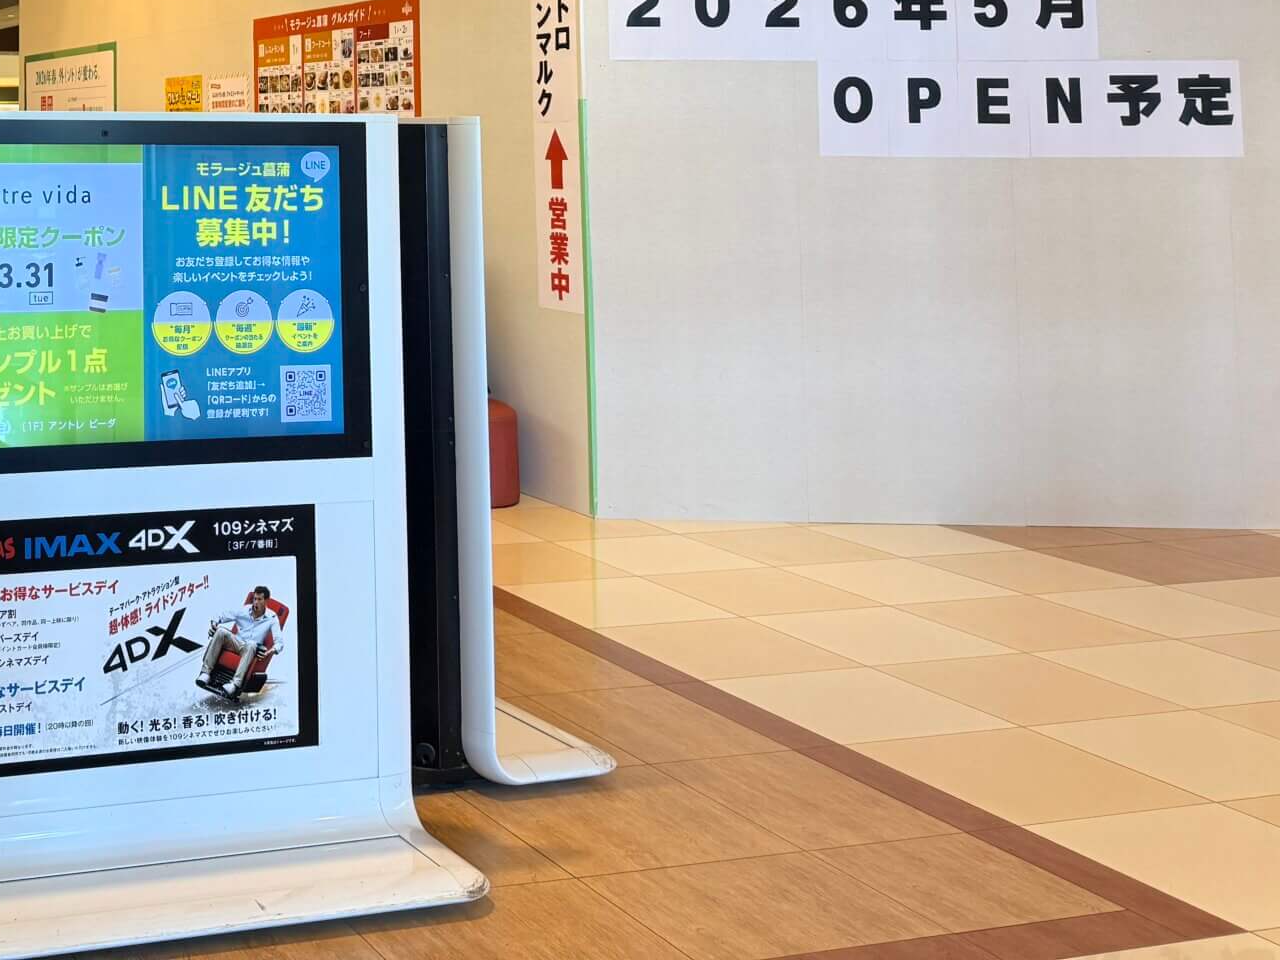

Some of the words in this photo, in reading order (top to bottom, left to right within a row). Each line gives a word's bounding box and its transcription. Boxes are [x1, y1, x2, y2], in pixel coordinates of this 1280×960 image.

[195, 162, 291, 177] モラージュ菖蒲
[305, 159, 326, 170] LINE
[41, 184, 92, 205] vida
[161, 185, 238, 211] LINE
[244, 183, 324, 213] 友だち
[195, 218, 290, 247] 募集中!
[548, 196, 570, 301] 営業中
[175, 255, 311, 268] お友だち登録してお得な情報や
[172, 269, 313, 283] 楽しいイベントをチェックしよう!
[33, 295, 49, 303] tue
[206, 367, 252, 377] LINEアプリ
[206, 407, 270, 419] 登録が便利です!
[48, 420, 84, 430] アントレ
[89, 418, 117, 429] ビーダ
[212, 516, 295, 537] 109シネマズ
[24, 532, 123, 560] IMAX
[128, 520, 201, 554] 4DX
[102, 607, 204, 675] 4DX
[213, 708, 278, 725] 吹き付ける!
